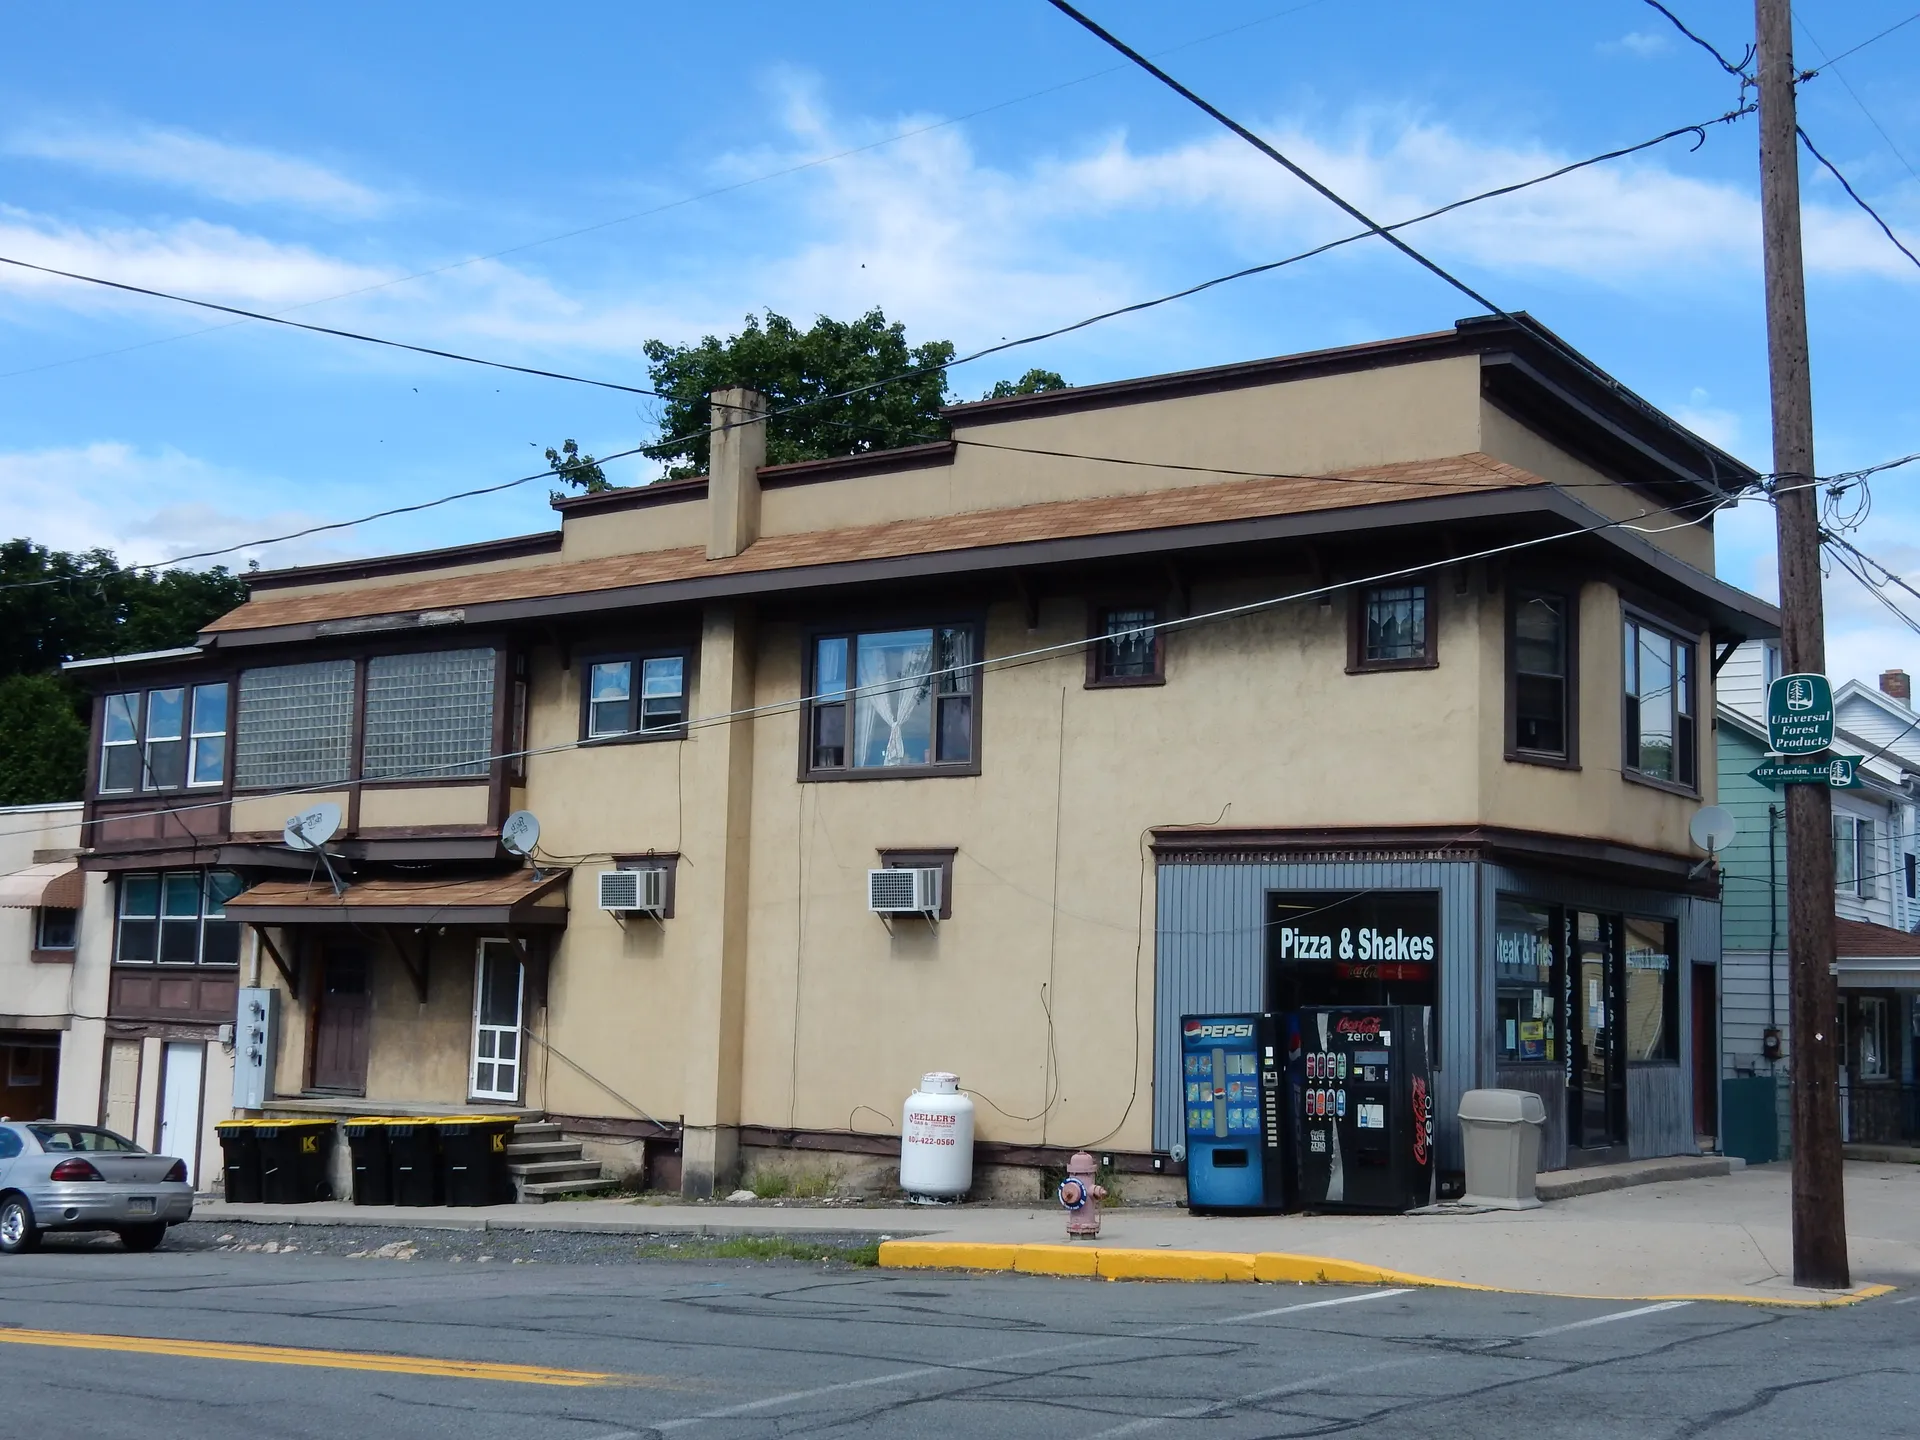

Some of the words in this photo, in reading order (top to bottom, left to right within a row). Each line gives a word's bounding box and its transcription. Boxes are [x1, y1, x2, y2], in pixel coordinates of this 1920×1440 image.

[1771, 711, 1831, 725] Universal
[1782, 724, 1819, 735] Forest
[1775, 736, 1829, 748] Products
[1281, 927, 1332, 959] Pizza
[1339, 927, 1354, 960] &
[1358, 928, 1434, 961] Shakes
[1522, 932, 1530, 965] &
[1531, 935, 1553, 967] Fries
[1200, 1024, 1253, 1037] PEPSI
[1336, 1016, 1382, 1033] Coca-Cola
[1347, 1033, 1374, 1042] zero
[914, 1113, 956, 1122] HELLER'S
[1412, 1073, 1427, 1165] Coca-Cola
[1424, 1096, 1432, 1146] zero
